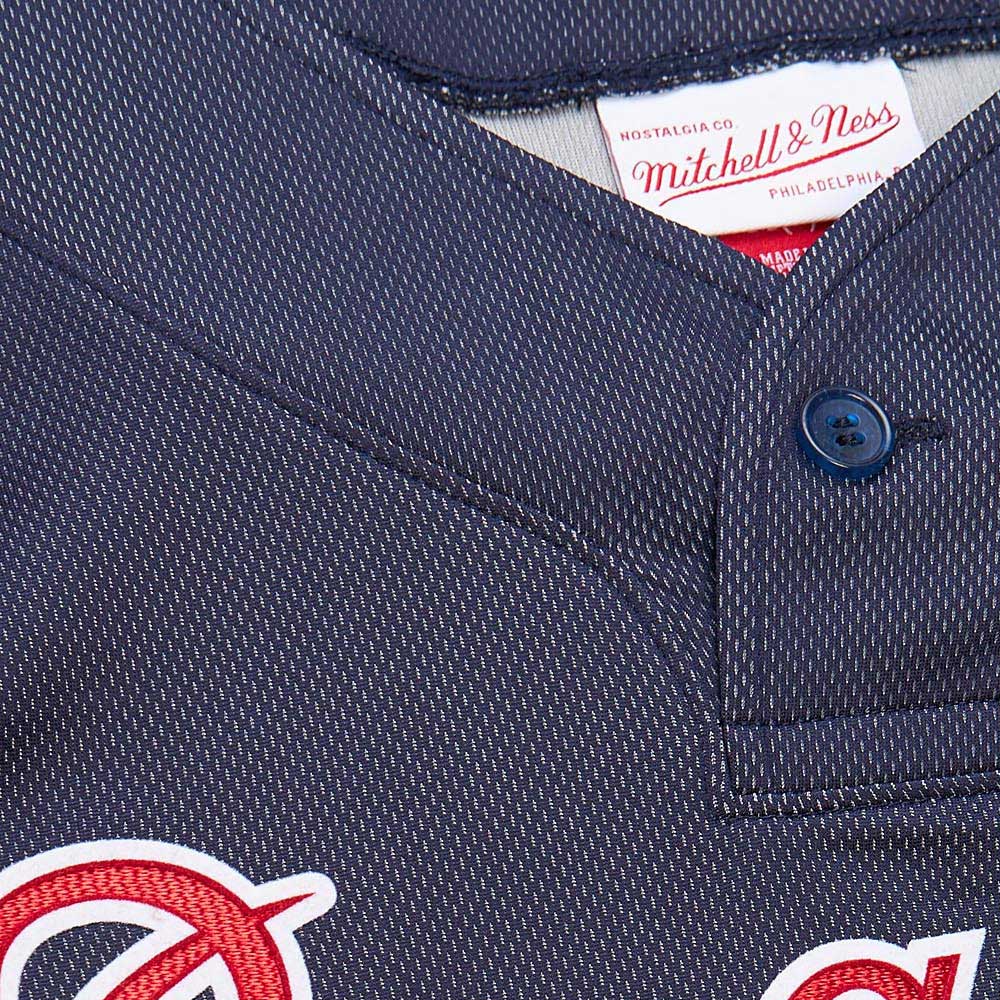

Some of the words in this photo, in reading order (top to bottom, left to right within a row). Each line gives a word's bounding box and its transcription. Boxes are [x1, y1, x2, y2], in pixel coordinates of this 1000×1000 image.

[620, 122, 710, 141] NOSTALGIA
[632, 123, 782, 193] Mitchell
[788, 120, 813, 155] &
[811, 102, 900, 144] Ness
